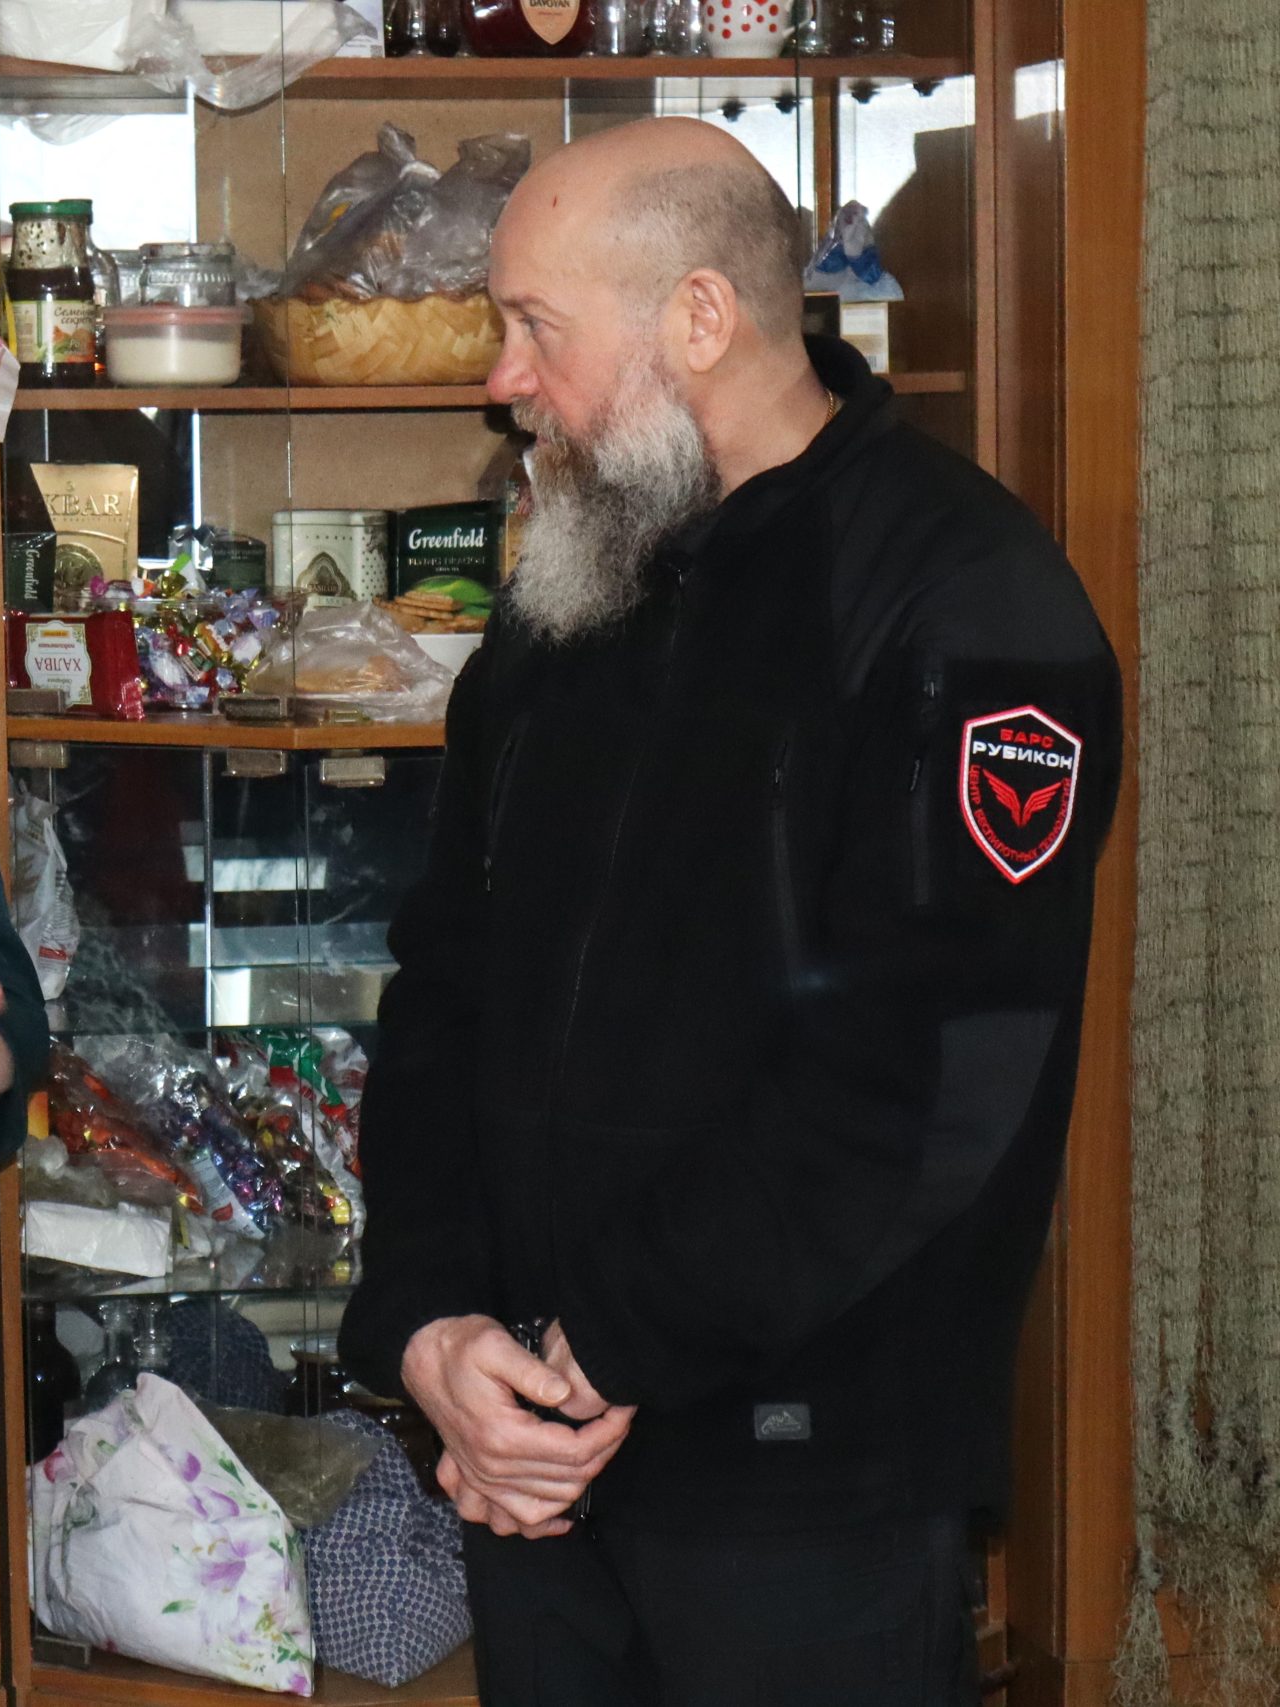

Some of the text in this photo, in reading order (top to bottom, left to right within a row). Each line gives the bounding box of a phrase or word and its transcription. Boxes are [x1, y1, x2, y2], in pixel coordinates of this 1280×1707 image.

[43, 493, 122, 516] KBAR
[408, 527, 485, 550] Greenfield
[24, 549, 39, 600] Greenfield
[34, 657, 82, 672] ХАЛВА
[1000, 728, 1055, 749] БАРС
[972, 741, 1073, 770] РУБИКОН
